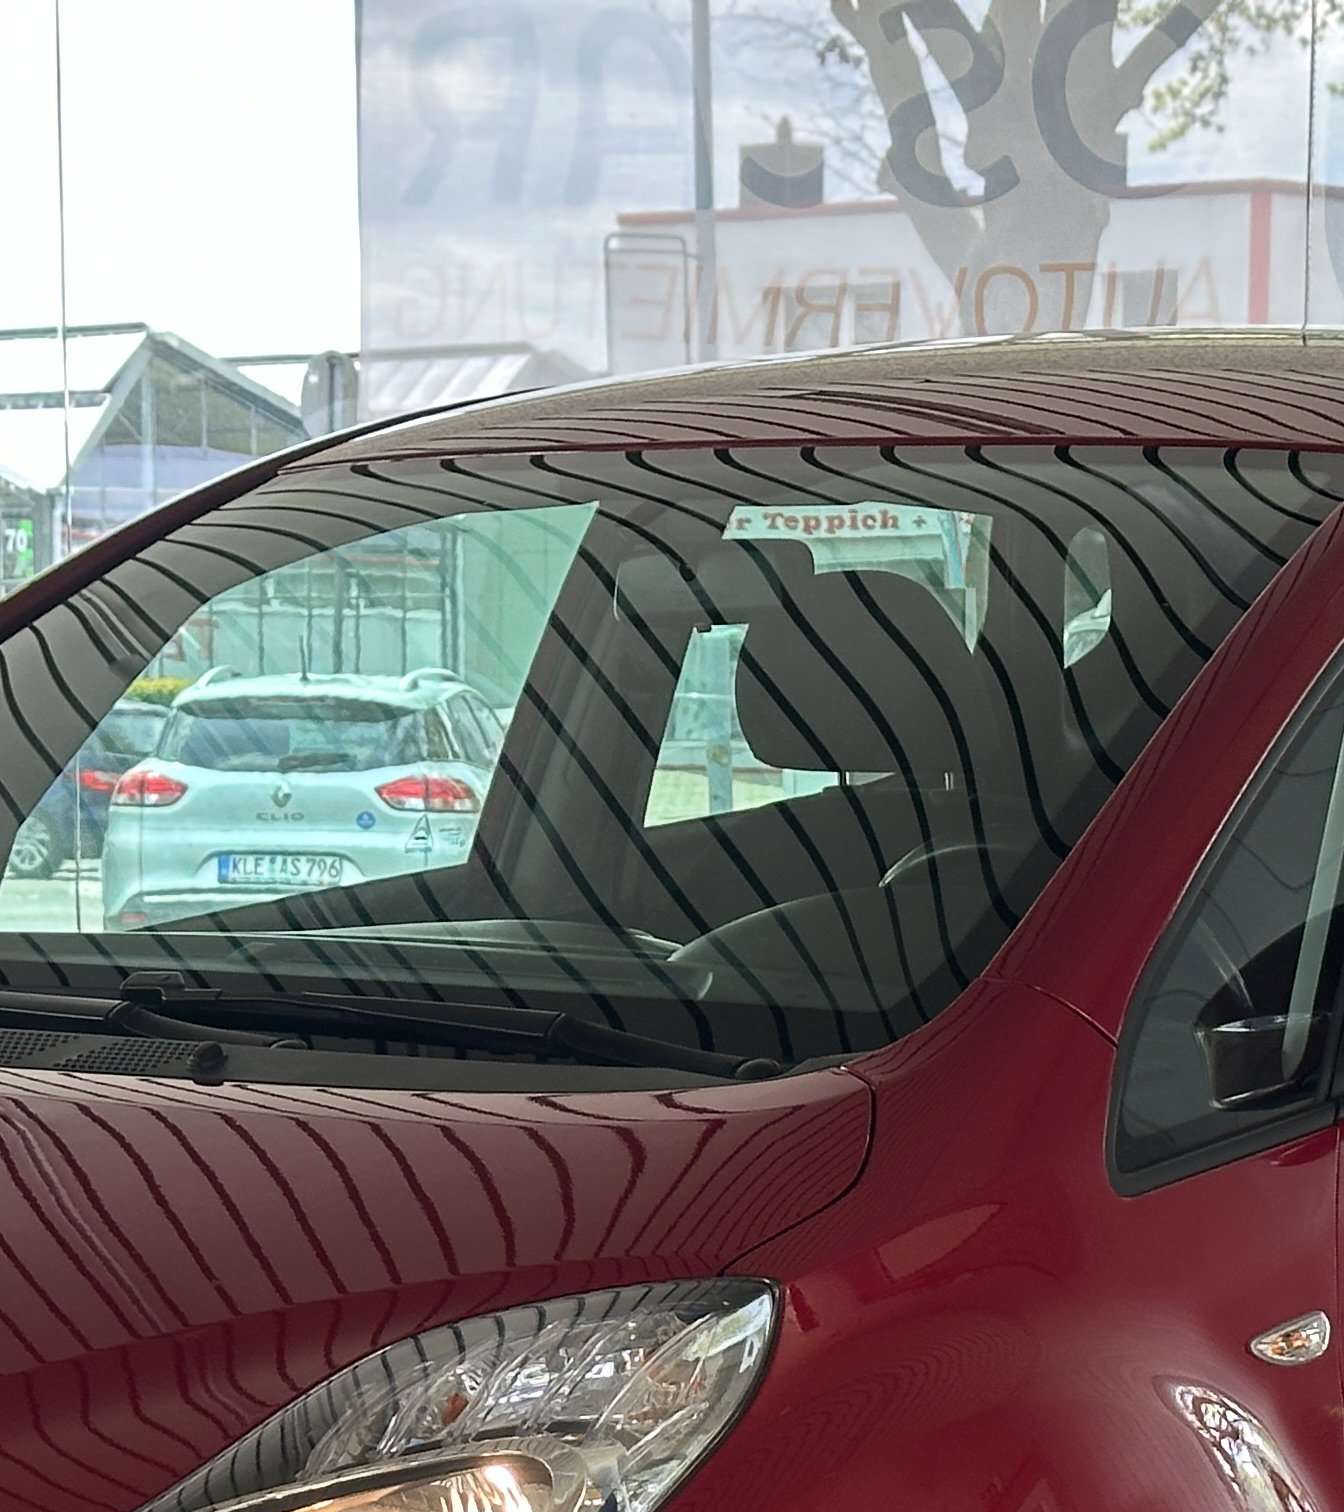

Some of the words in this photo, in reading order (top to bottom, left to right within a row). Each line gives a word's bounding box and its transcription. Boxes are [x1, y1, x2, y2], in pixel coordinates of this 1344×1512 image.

[763, 508, 899, 535] Teppich
[233, 857, 265, 876] KLE
[279, 857, 301, 877] AS
[306, 858, 340, 879] 796
